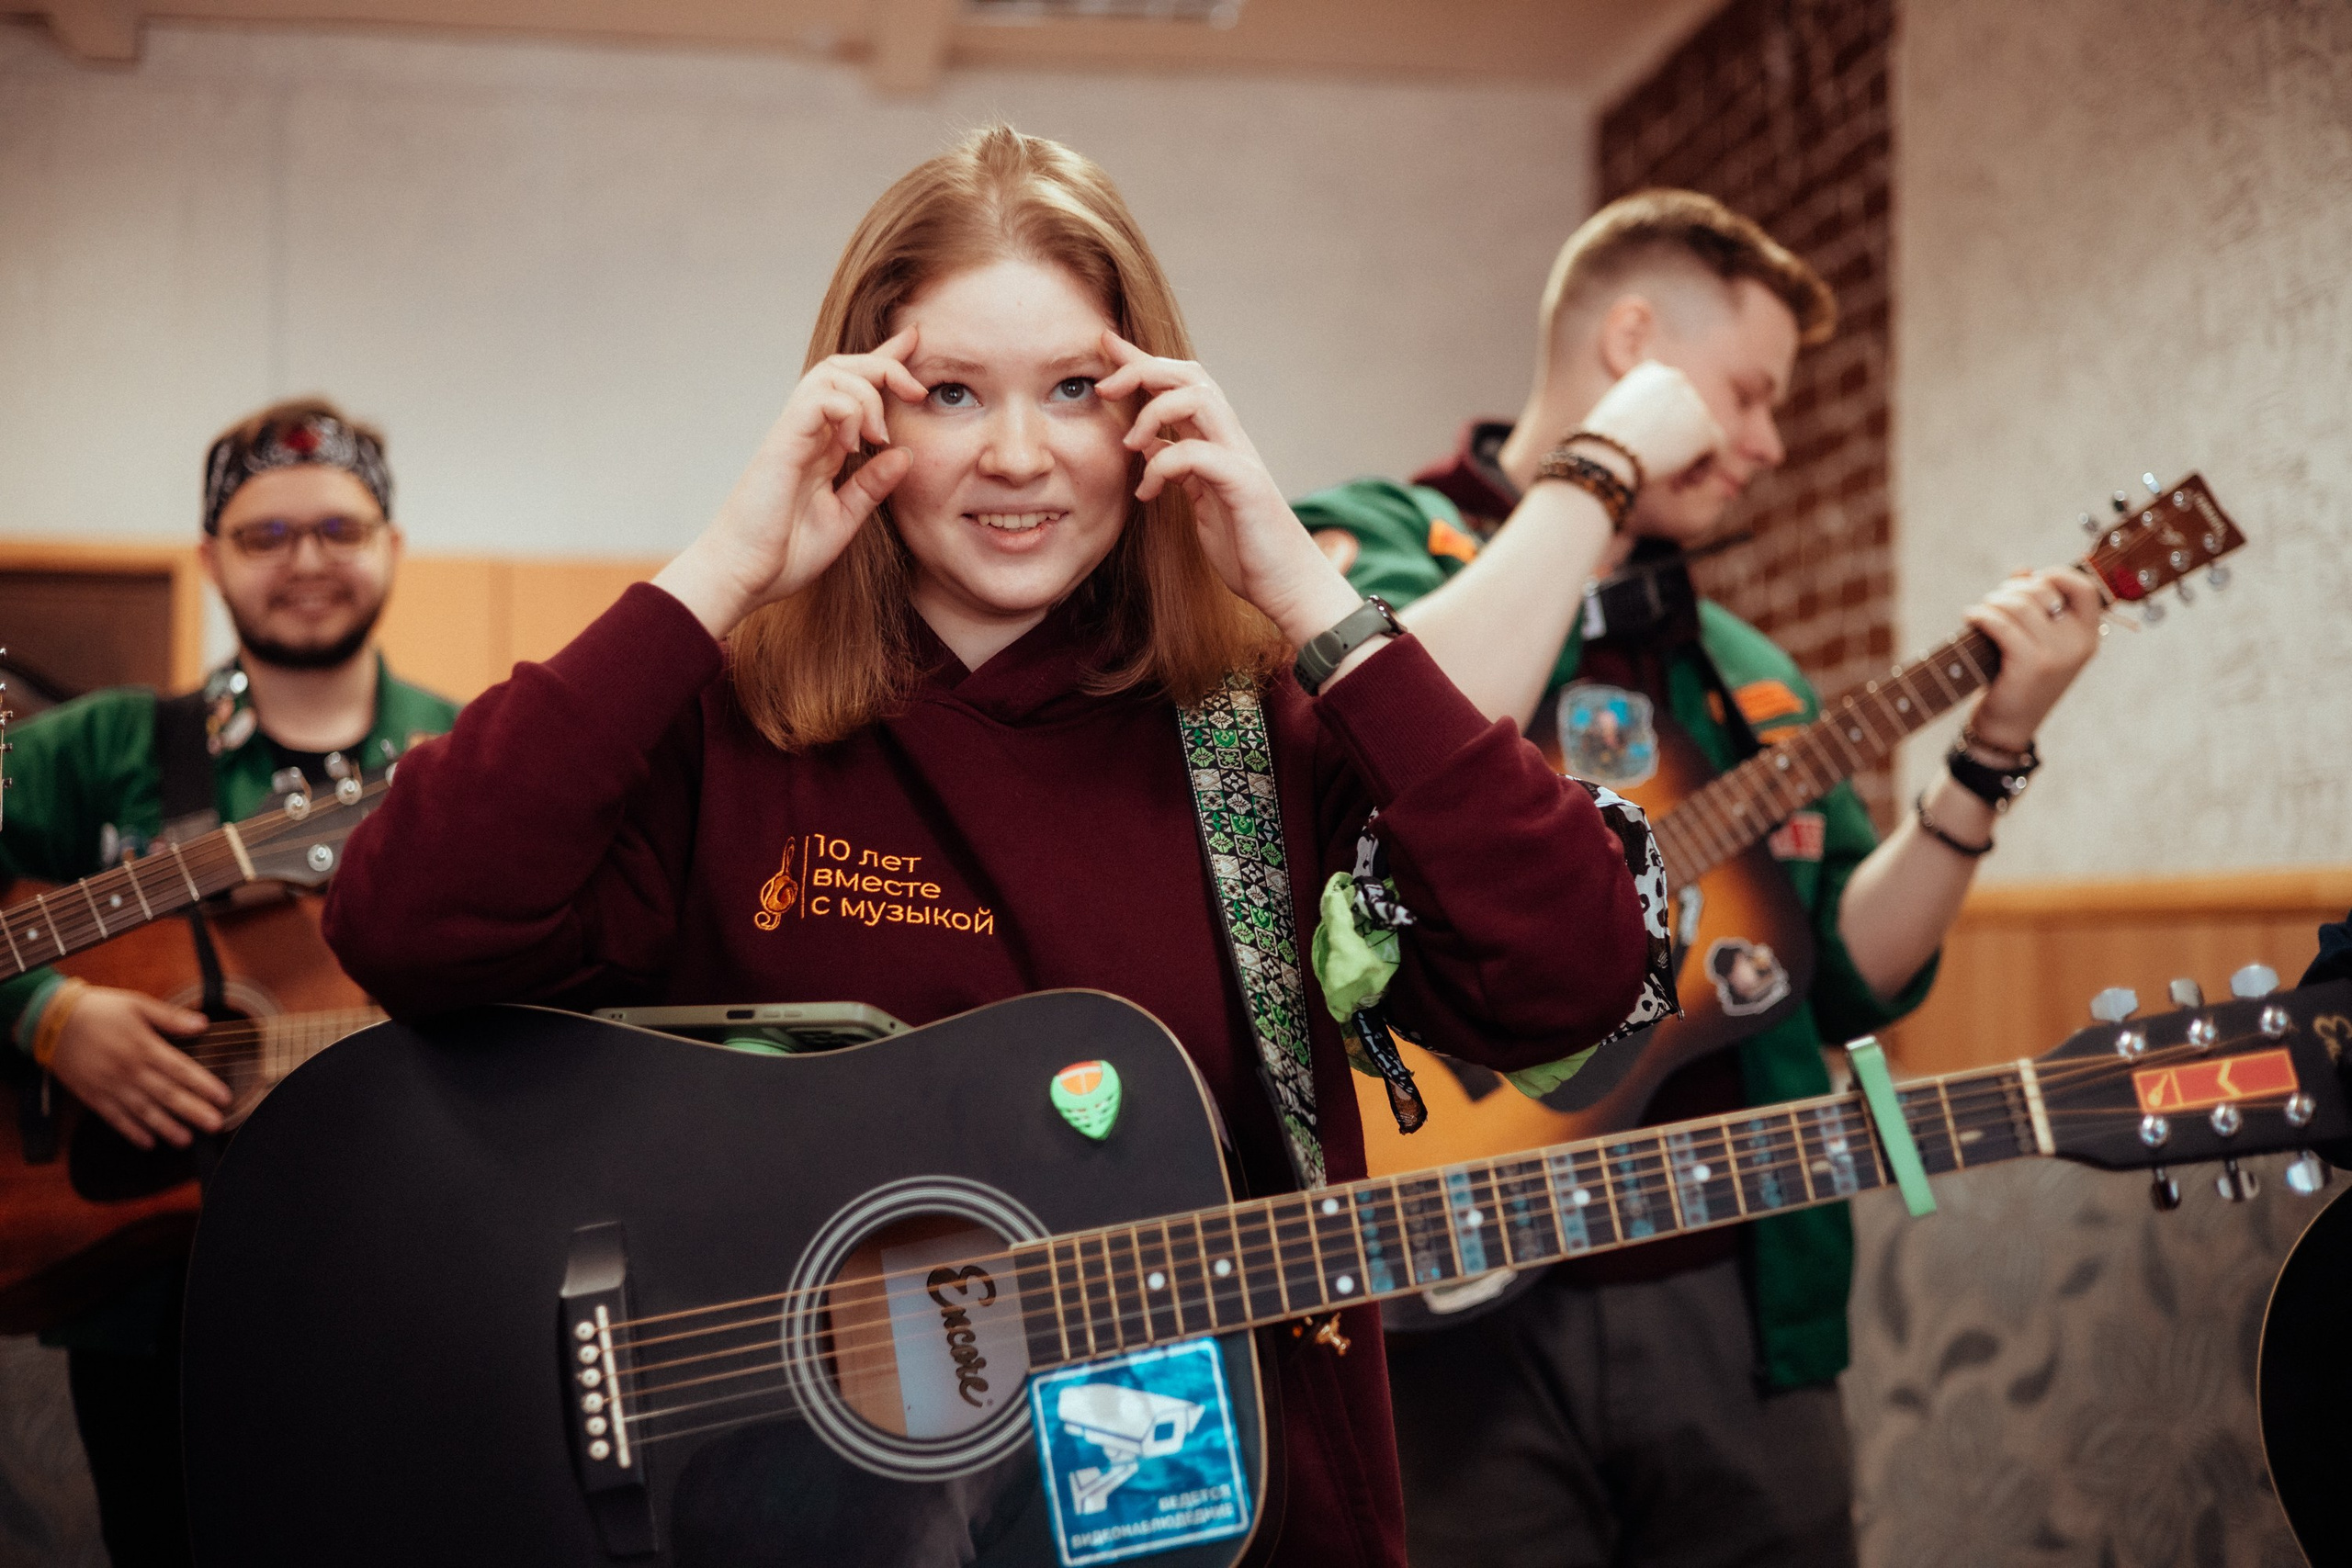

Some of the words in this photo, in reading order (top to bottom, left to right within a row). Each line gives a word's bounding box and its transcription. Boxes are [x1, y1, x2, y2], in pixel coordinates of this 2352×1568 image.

[814, 834, 851, 862] 10
[858, 850, 922, 874] лет
[812, 868, 942, 899] вместе
[810, 897, 831, 916] с
[841, 897, 994, 935] музыкой
[926, 1265, 997, 1408] Encore
